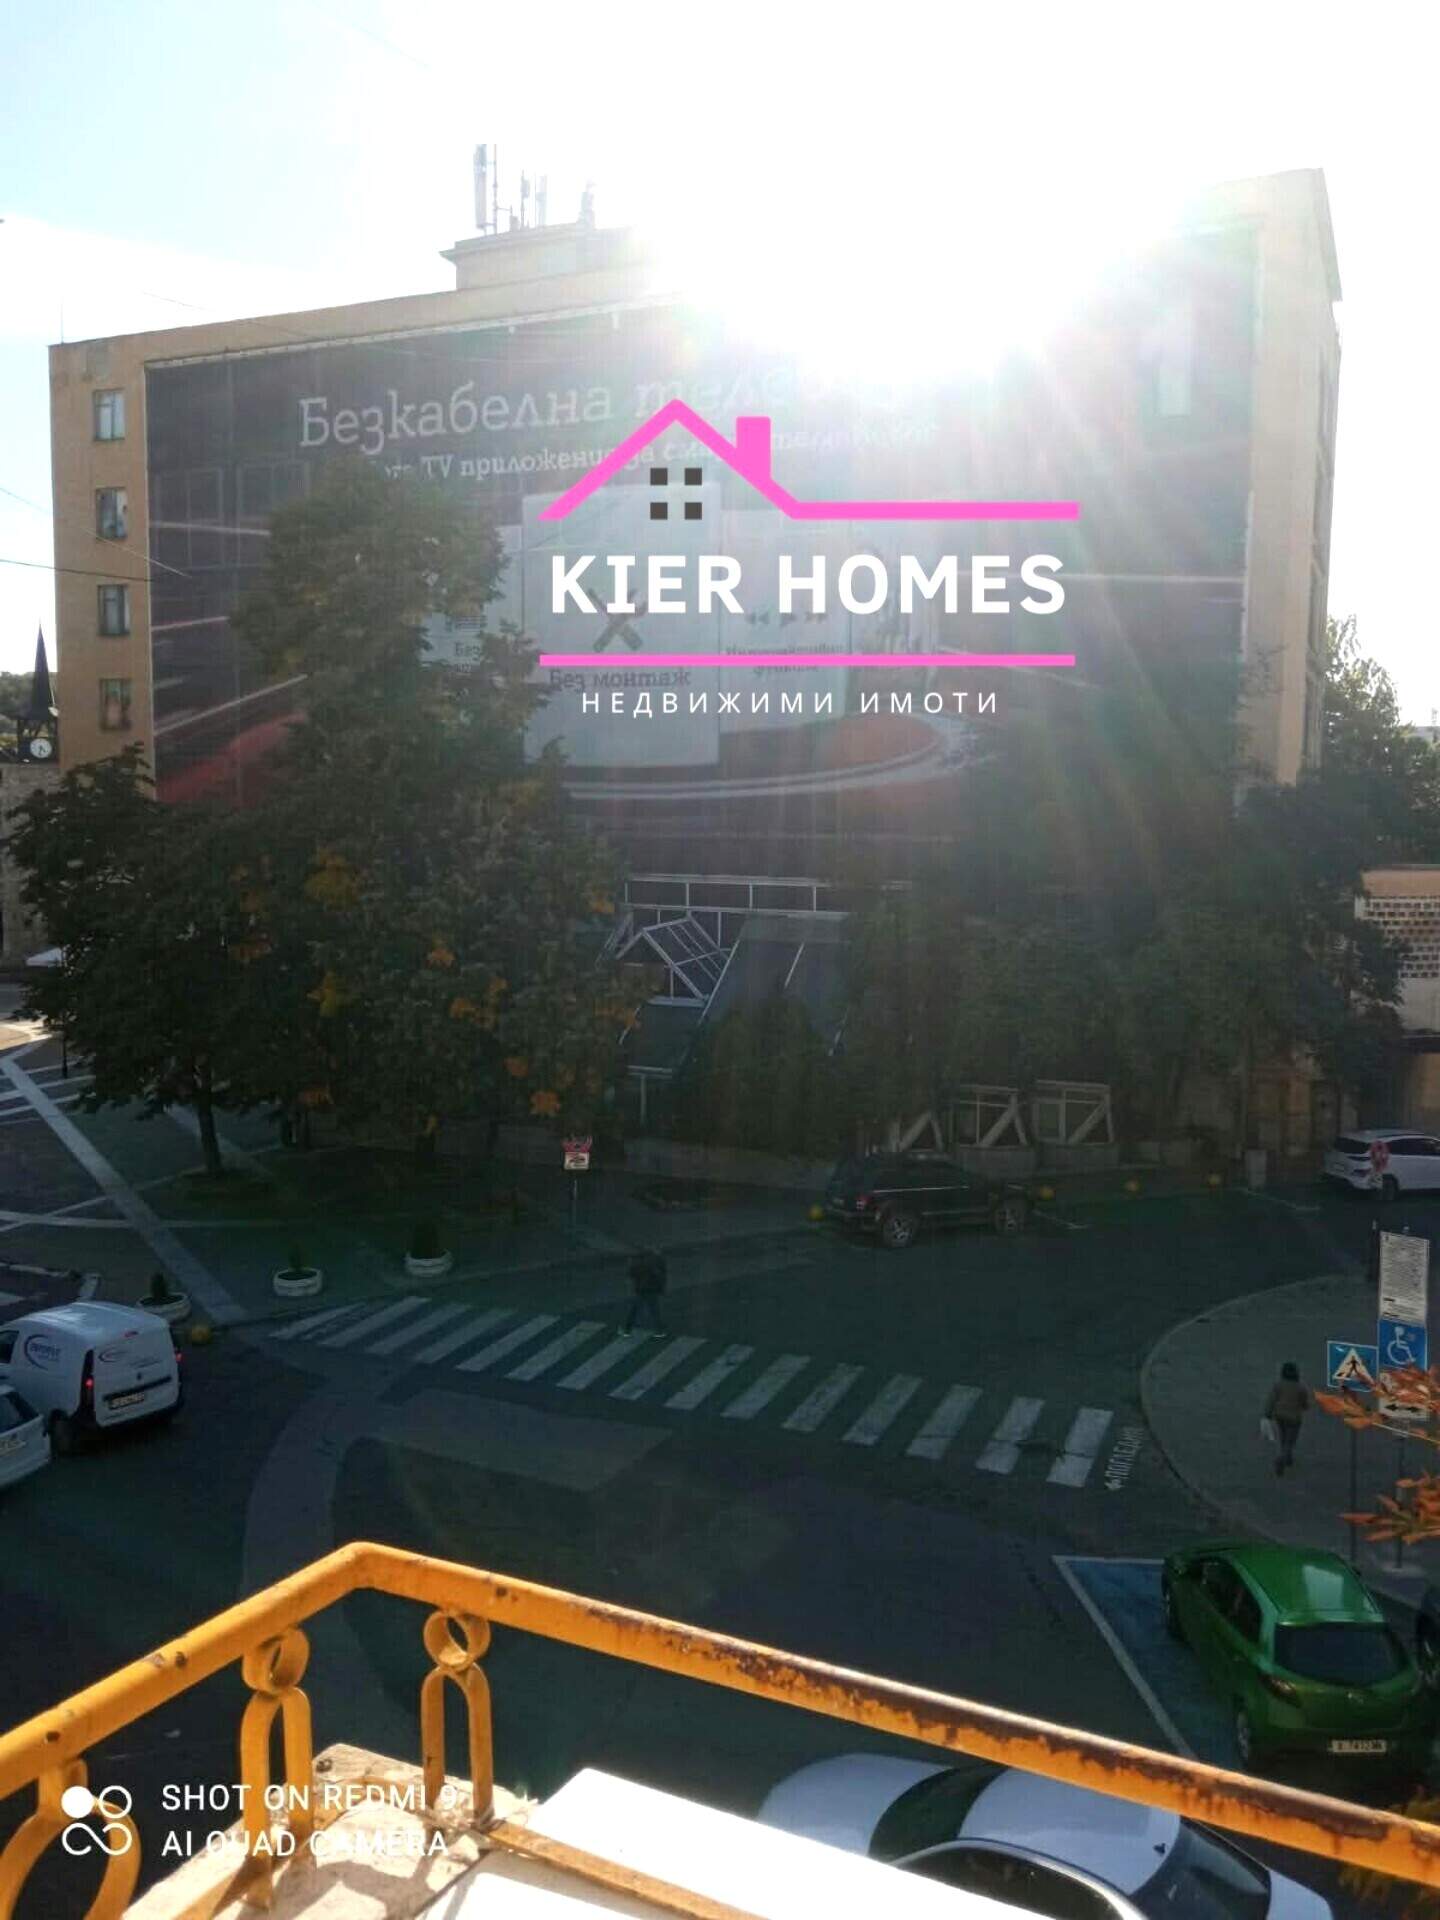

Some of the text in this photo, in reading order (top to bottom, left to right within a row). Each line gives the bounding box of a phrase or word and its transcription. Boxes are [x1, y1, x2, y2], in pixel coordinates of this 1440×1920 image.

[299, 381, 612, 455] Безкабелна
[420, 454, 454, 480] TV
[460, 448, 616, 481] приложени
[550, 667, 691, 692] Без монтаж
